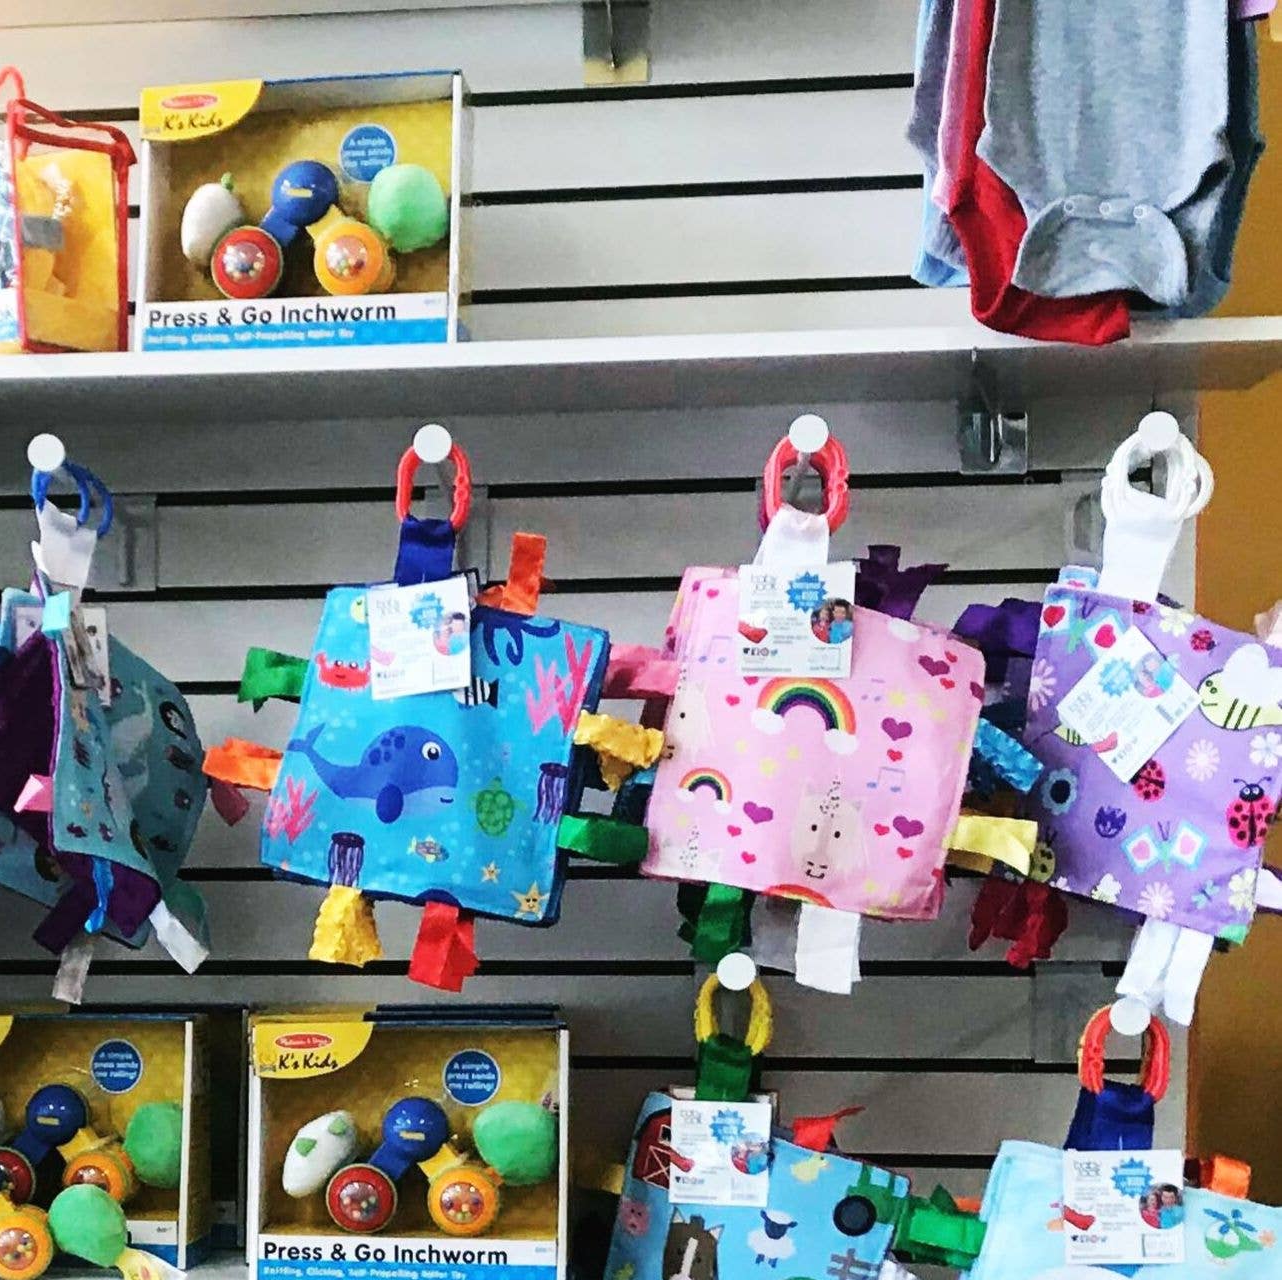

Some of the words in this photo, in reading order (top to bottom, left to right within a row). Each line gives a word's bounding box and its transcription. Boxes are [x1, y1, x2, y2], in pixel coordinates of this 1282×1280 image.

[149, 310, 208, 328] Press
[218, 308, 232, 325] &
[241, 306, 271, 325] Go
[281, 303, 396, 324] Inchworm
[278, 1053, 298, 1069] K's
[303, 1052, 338, 1069] Kids
[263, 1242, 323, 1261] Press
[330, 1243, 346, 1262] &
[355, 1244, 386, 1262] Go
[394, 1244, 507, 1265] Inchworm
